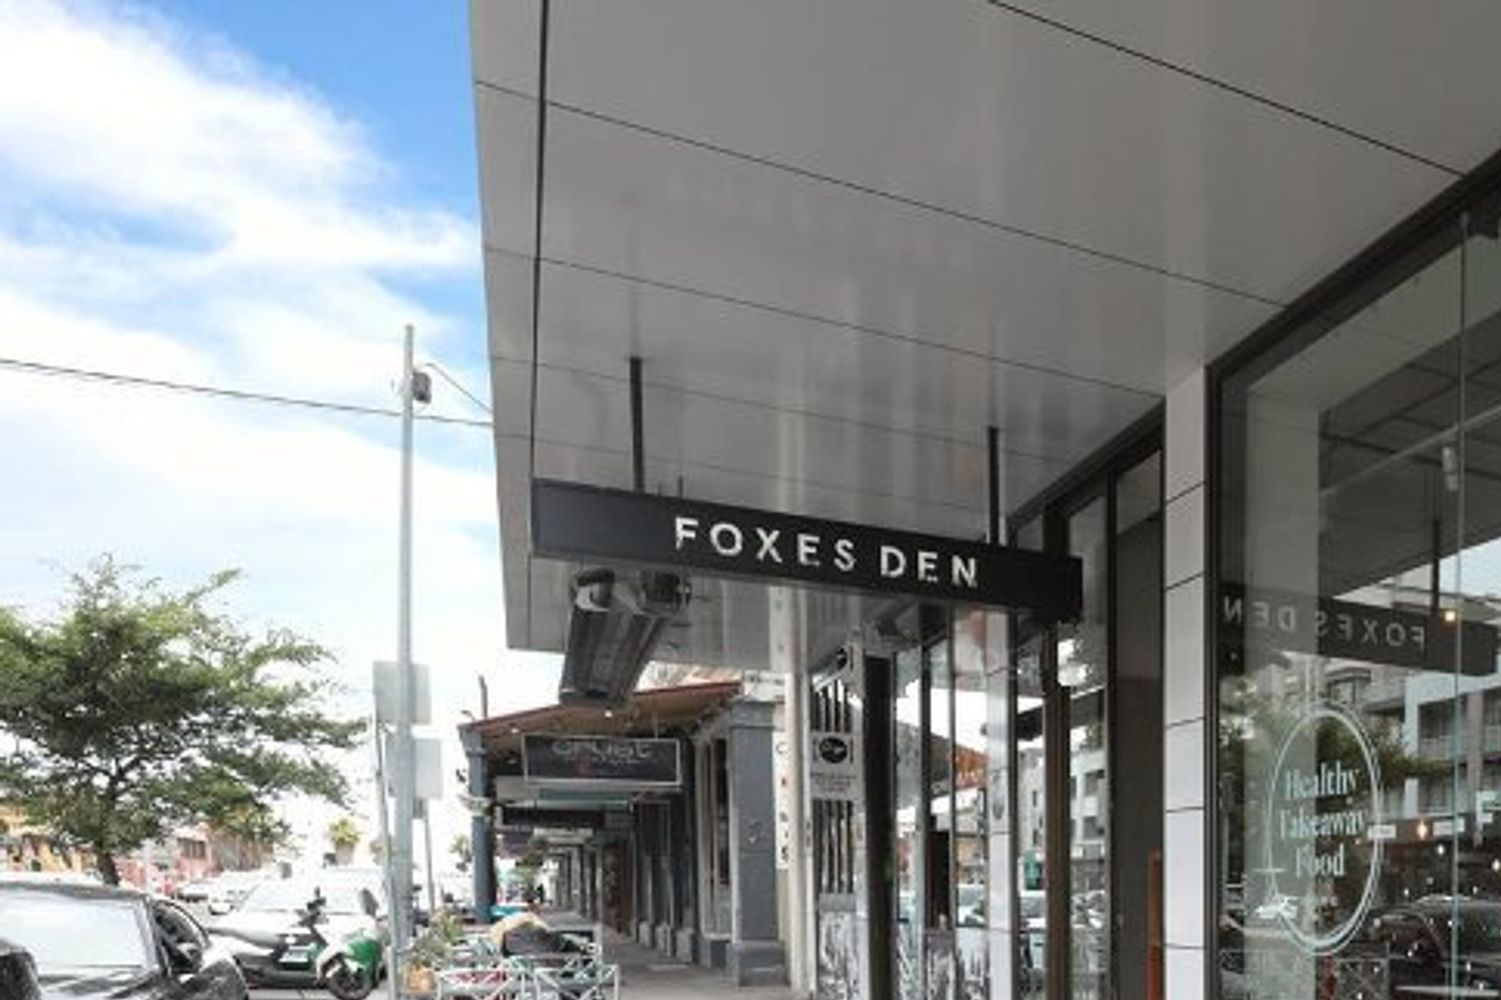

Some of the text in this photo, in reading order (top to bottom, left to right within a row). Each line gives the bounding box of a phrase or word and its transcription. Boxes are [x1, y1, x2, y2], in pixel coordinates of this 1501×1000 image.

[674, 516, 980, 588] FOXES DEN
[1285, 760, 1360, 799] Healthy
[1279, 808, 1368, 842] Takeaway
[1295, 844, 1346, 879] Food
